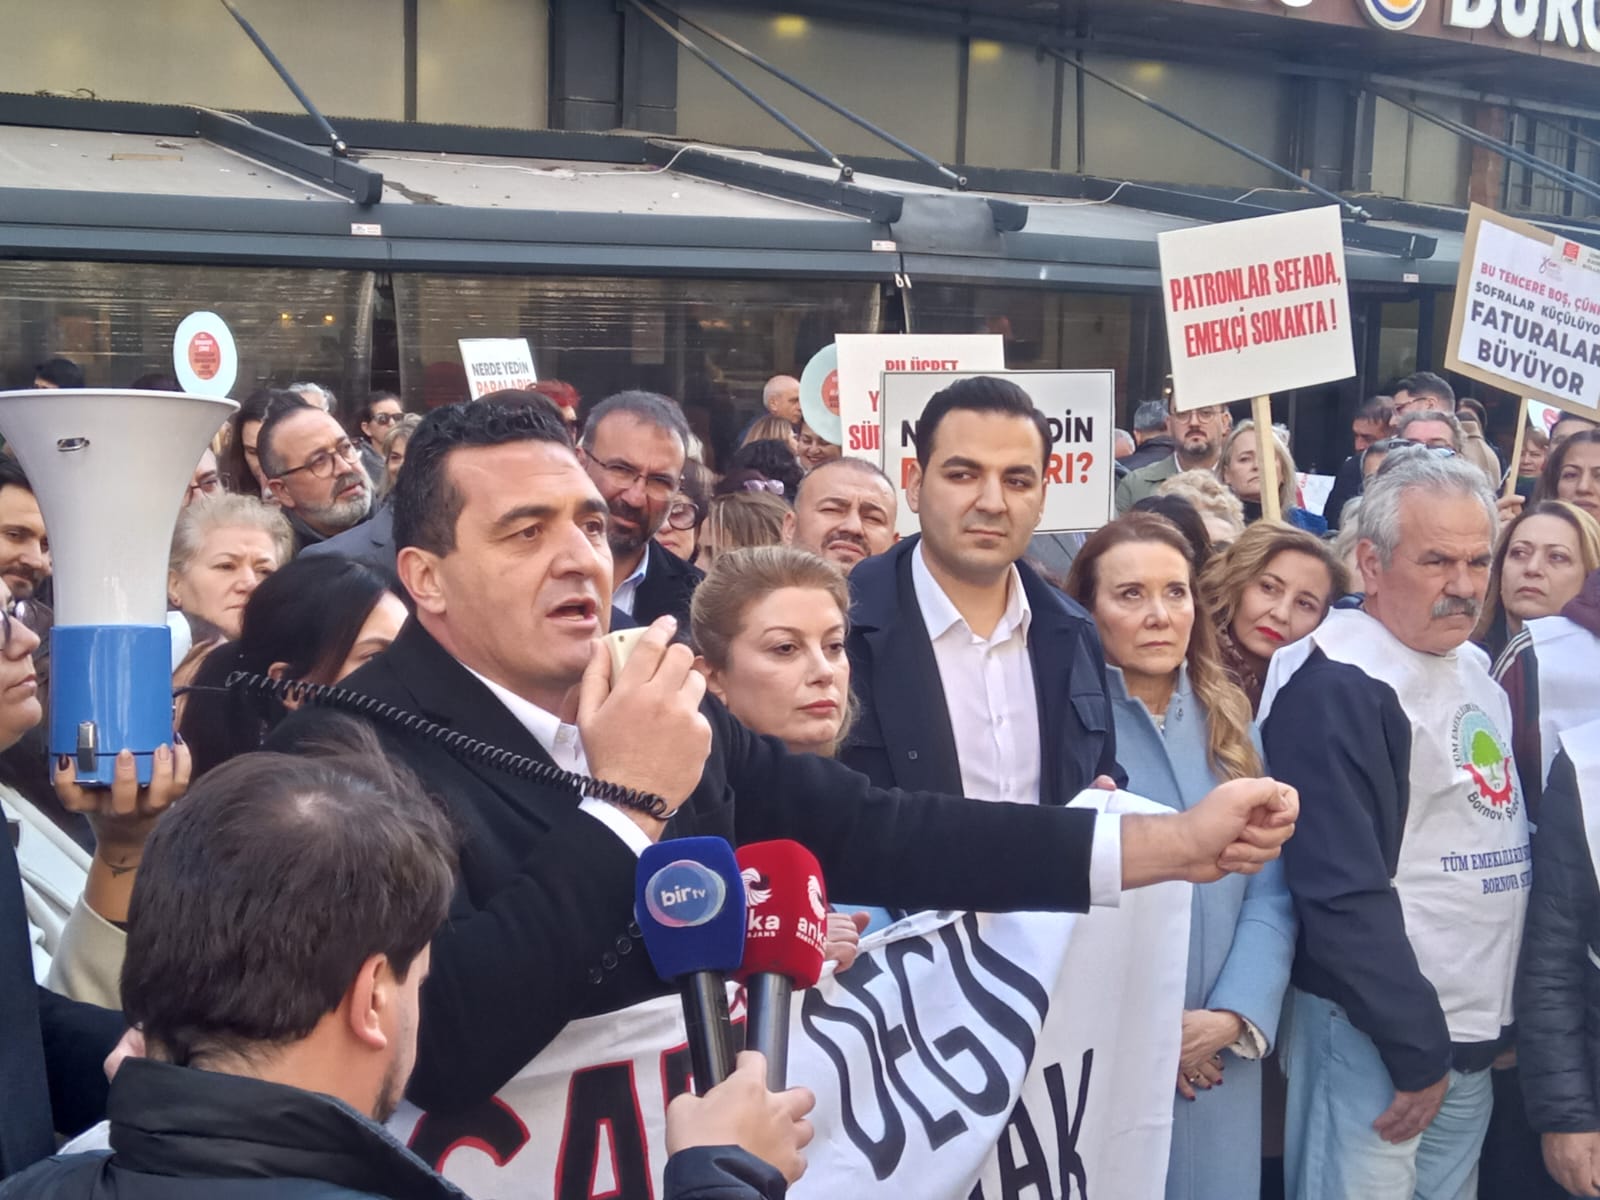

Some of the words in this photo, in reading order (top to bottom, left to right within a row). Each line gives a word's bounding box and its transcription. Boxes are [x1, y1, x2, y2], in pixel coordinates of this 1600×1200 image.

[1170, 263, 1271, 312] PATRONLAR
[1273, 252, 1341, 294] SEFADA,
[1481, 262, 1496, 278] BU
[1499, 268, 1547, 296] TENCERE
[1184, 306, 1248, 358] EMEKÇİ
[1250, 300, 1328, 345] SOKAKTA
[1471, 299, 1600, 368] FATURALAR
[1474, 281, 1535, 312] SOFRALAR
[1541, 305, 1600, 336] KÜÇÜLÜYO
[471, 361, 503, 376] NERDE
[1477, 338, 1584, 396] BÜYÜYOR
[1440, 851, 1469, 872] TÜM
[748, 908, 780, 930] ka
